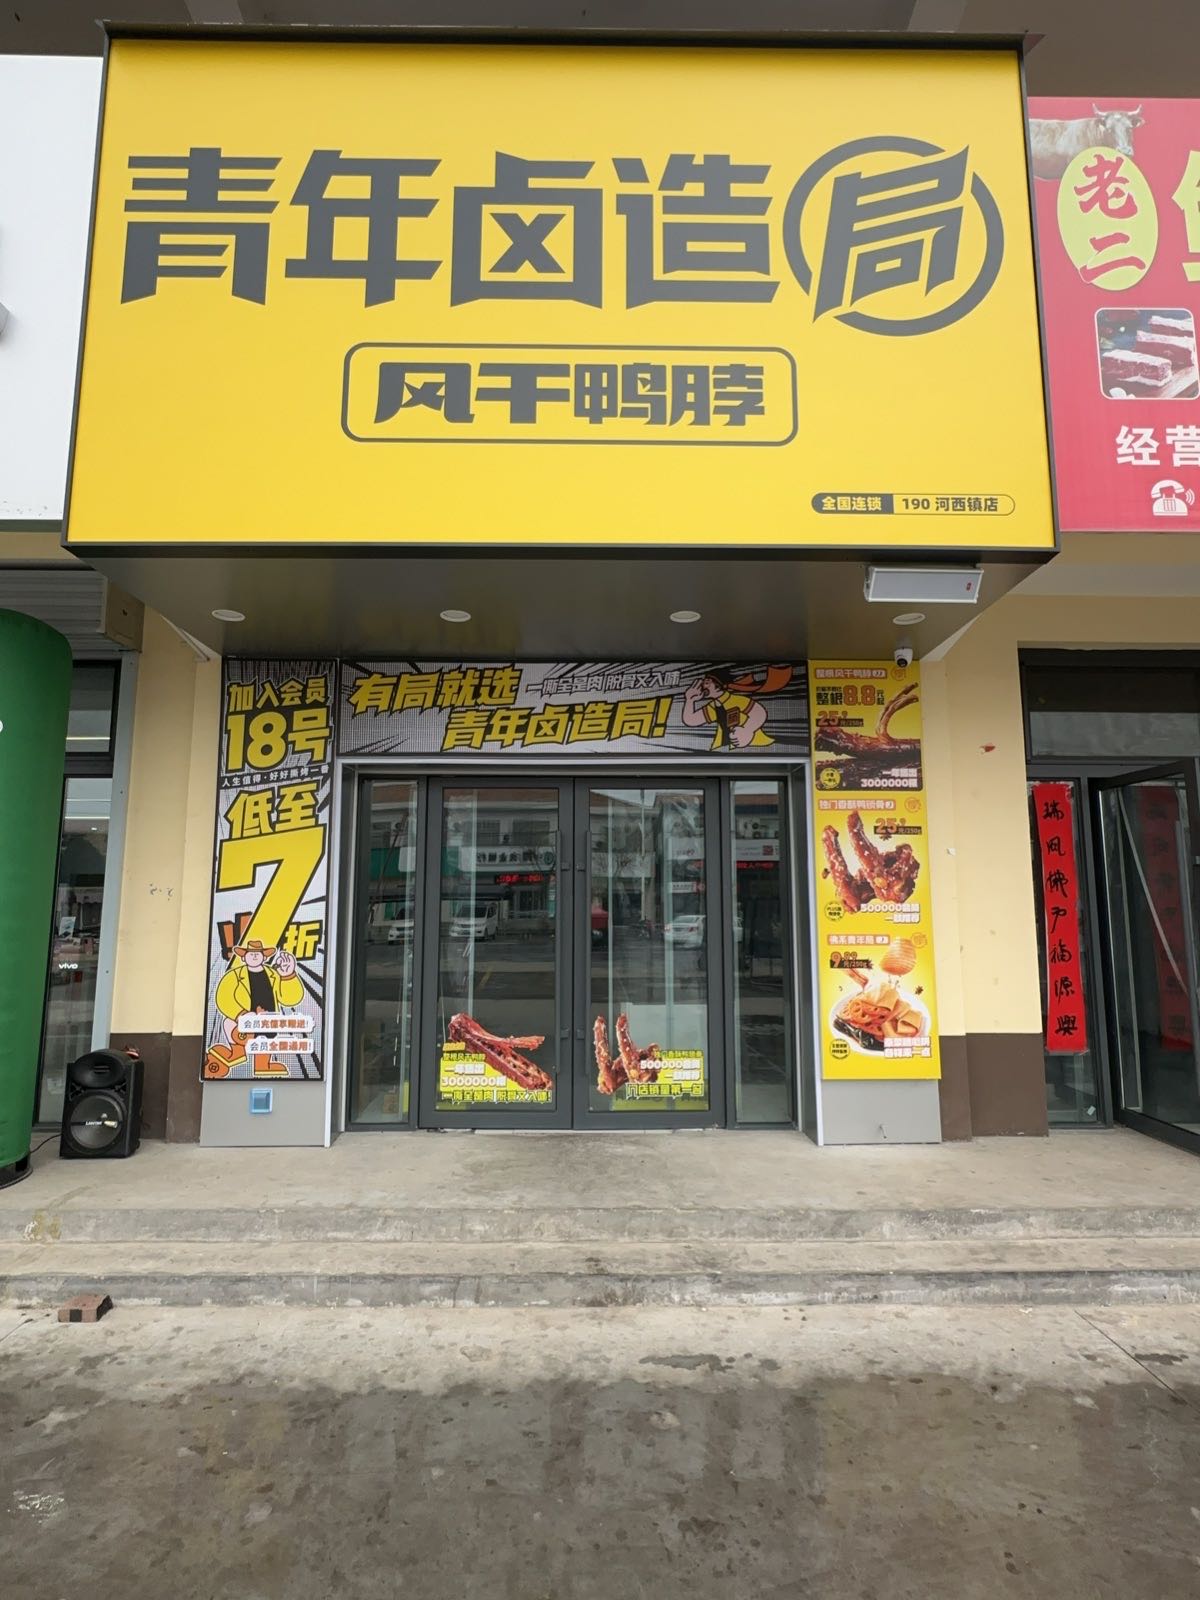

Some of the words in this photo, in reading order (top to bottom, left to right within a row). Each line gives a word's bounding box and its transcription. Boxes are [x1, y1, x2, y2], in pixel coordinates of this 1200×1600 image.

[121, 146, 970, 323] 青年卤造局
[1074, 154, 1145, 283] 老二
[373, 362, 765, 426] 风干鸭脖
[822, 496, 882, 511] 全国连锁
[902, 498, 930, 510] 190
[935, 497, 998, 512] 河西镇店
[229, 677, 326, 713] 加入会员
[350, 667, 522, 718] 有局就选
[843, 685, 875, 706] 8.8
[227, 706, 330, 771] 18号
[442, 697, 672, 750] 青年卤造局!
[227, 782, 318, 839] 低至
